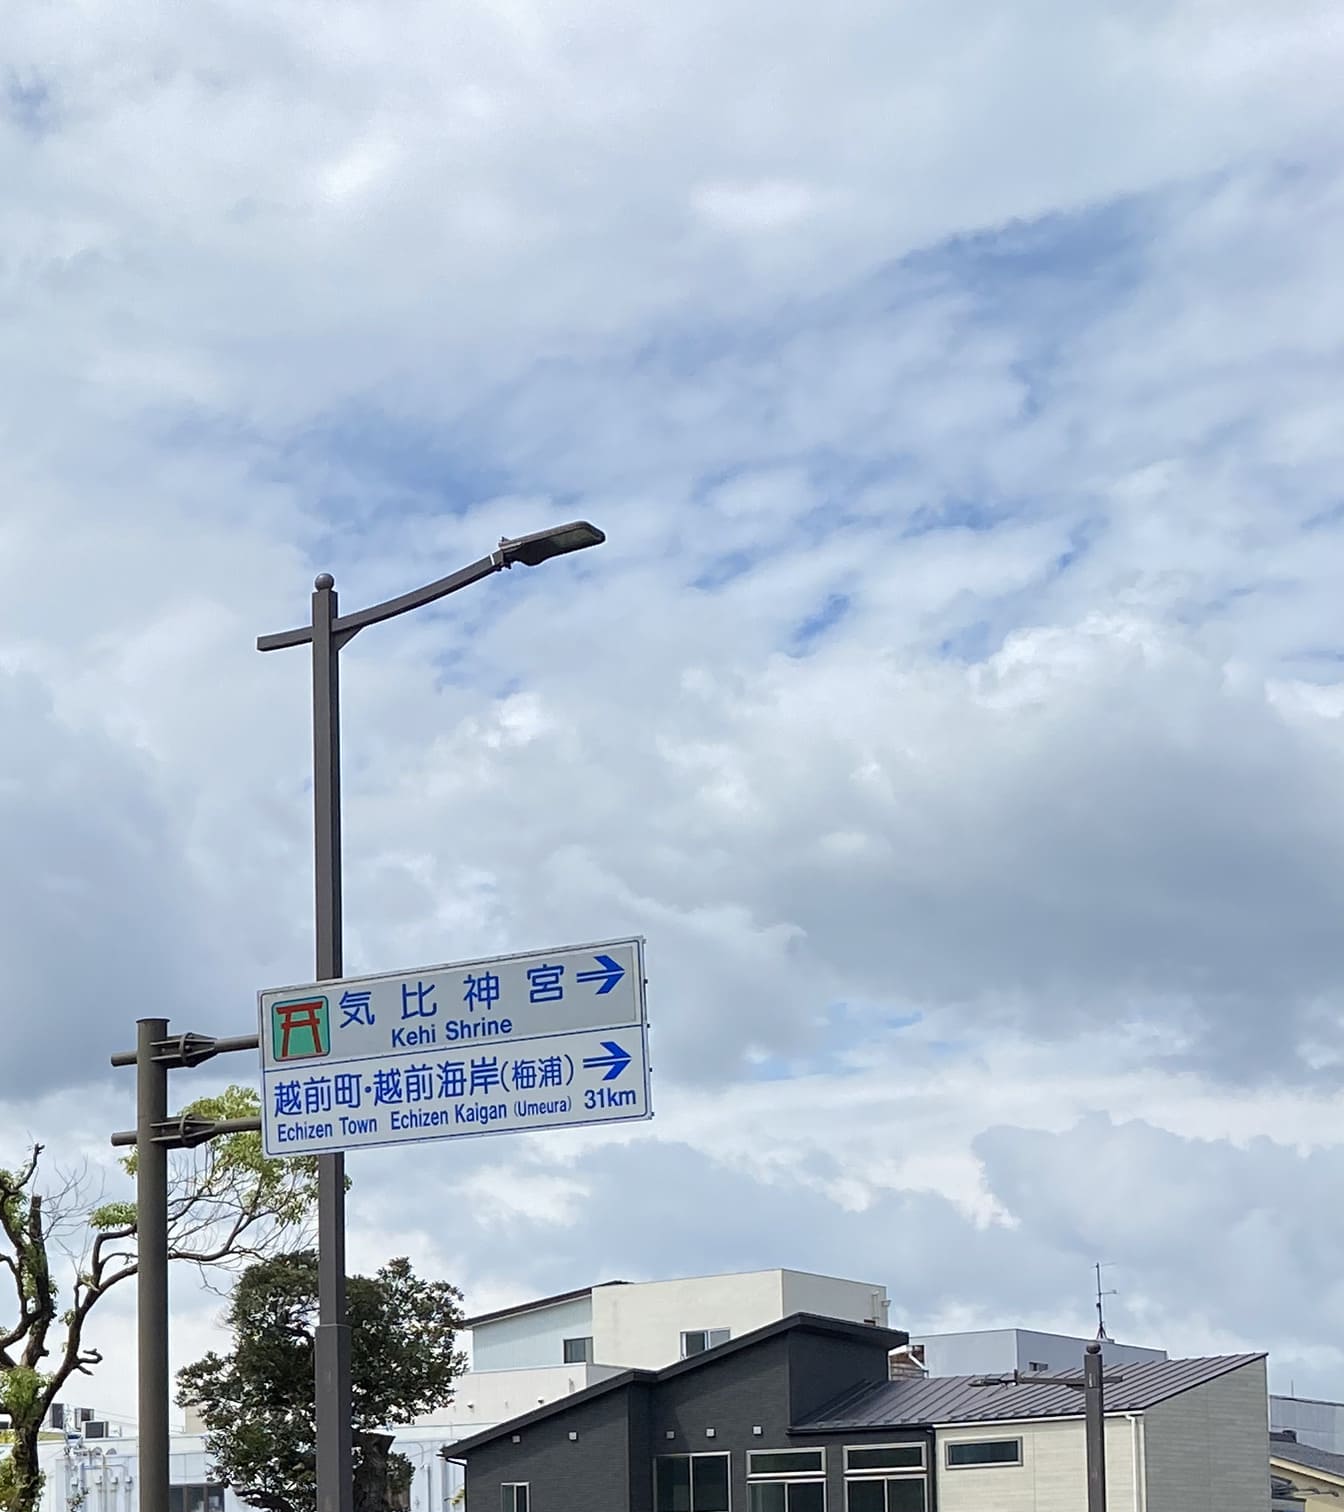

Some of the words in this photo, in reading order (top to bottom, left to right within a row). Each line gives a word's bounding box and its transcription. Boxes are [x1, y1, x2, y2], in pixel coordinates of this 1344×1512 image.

[338, 963, 565, 1029] 気比神宮
[391, 1023, 436, 1048] Kehi
[445, 1017, 513, 1041] Shrine
[277, 1120, 333, 1143] Echizen
[339, 1116, 378, 1136] Town
[391, 1107, 449, 1131] Echizen
[454, 1101, 508, 1125] Kaigan
[513, 1095, 573, 1118] (Umeura)
[583, 1087, 637, 1110] 31km
